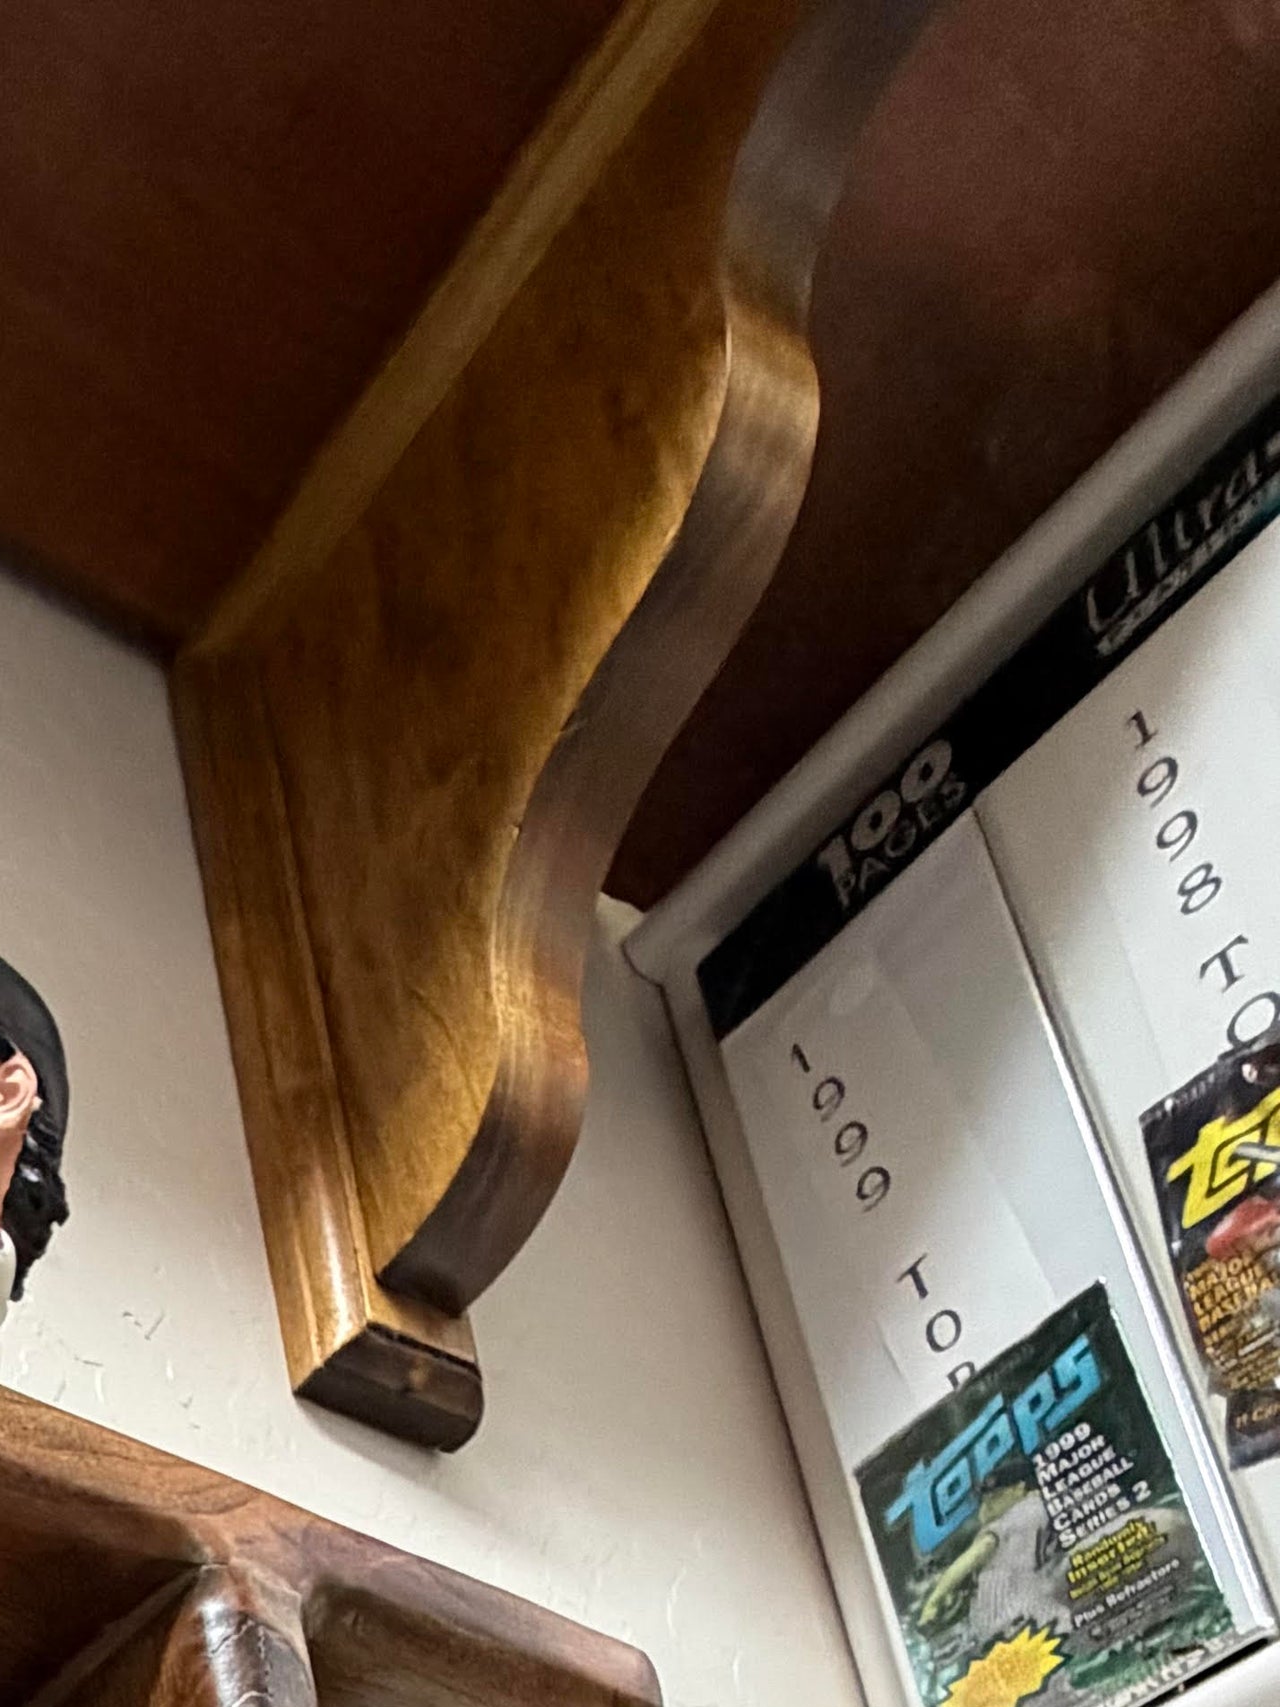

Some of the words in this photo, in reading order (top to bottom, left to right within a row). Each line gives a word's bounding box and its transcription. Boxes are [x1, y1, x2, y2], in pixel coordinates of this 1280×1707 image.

[1127, 709, 1223, 917] 1998
[790, 1042, 892, 1213] 1999
[1033, 1422, 1090, 1469] 1999
[1132, 1480, 1151, 1502] 2
